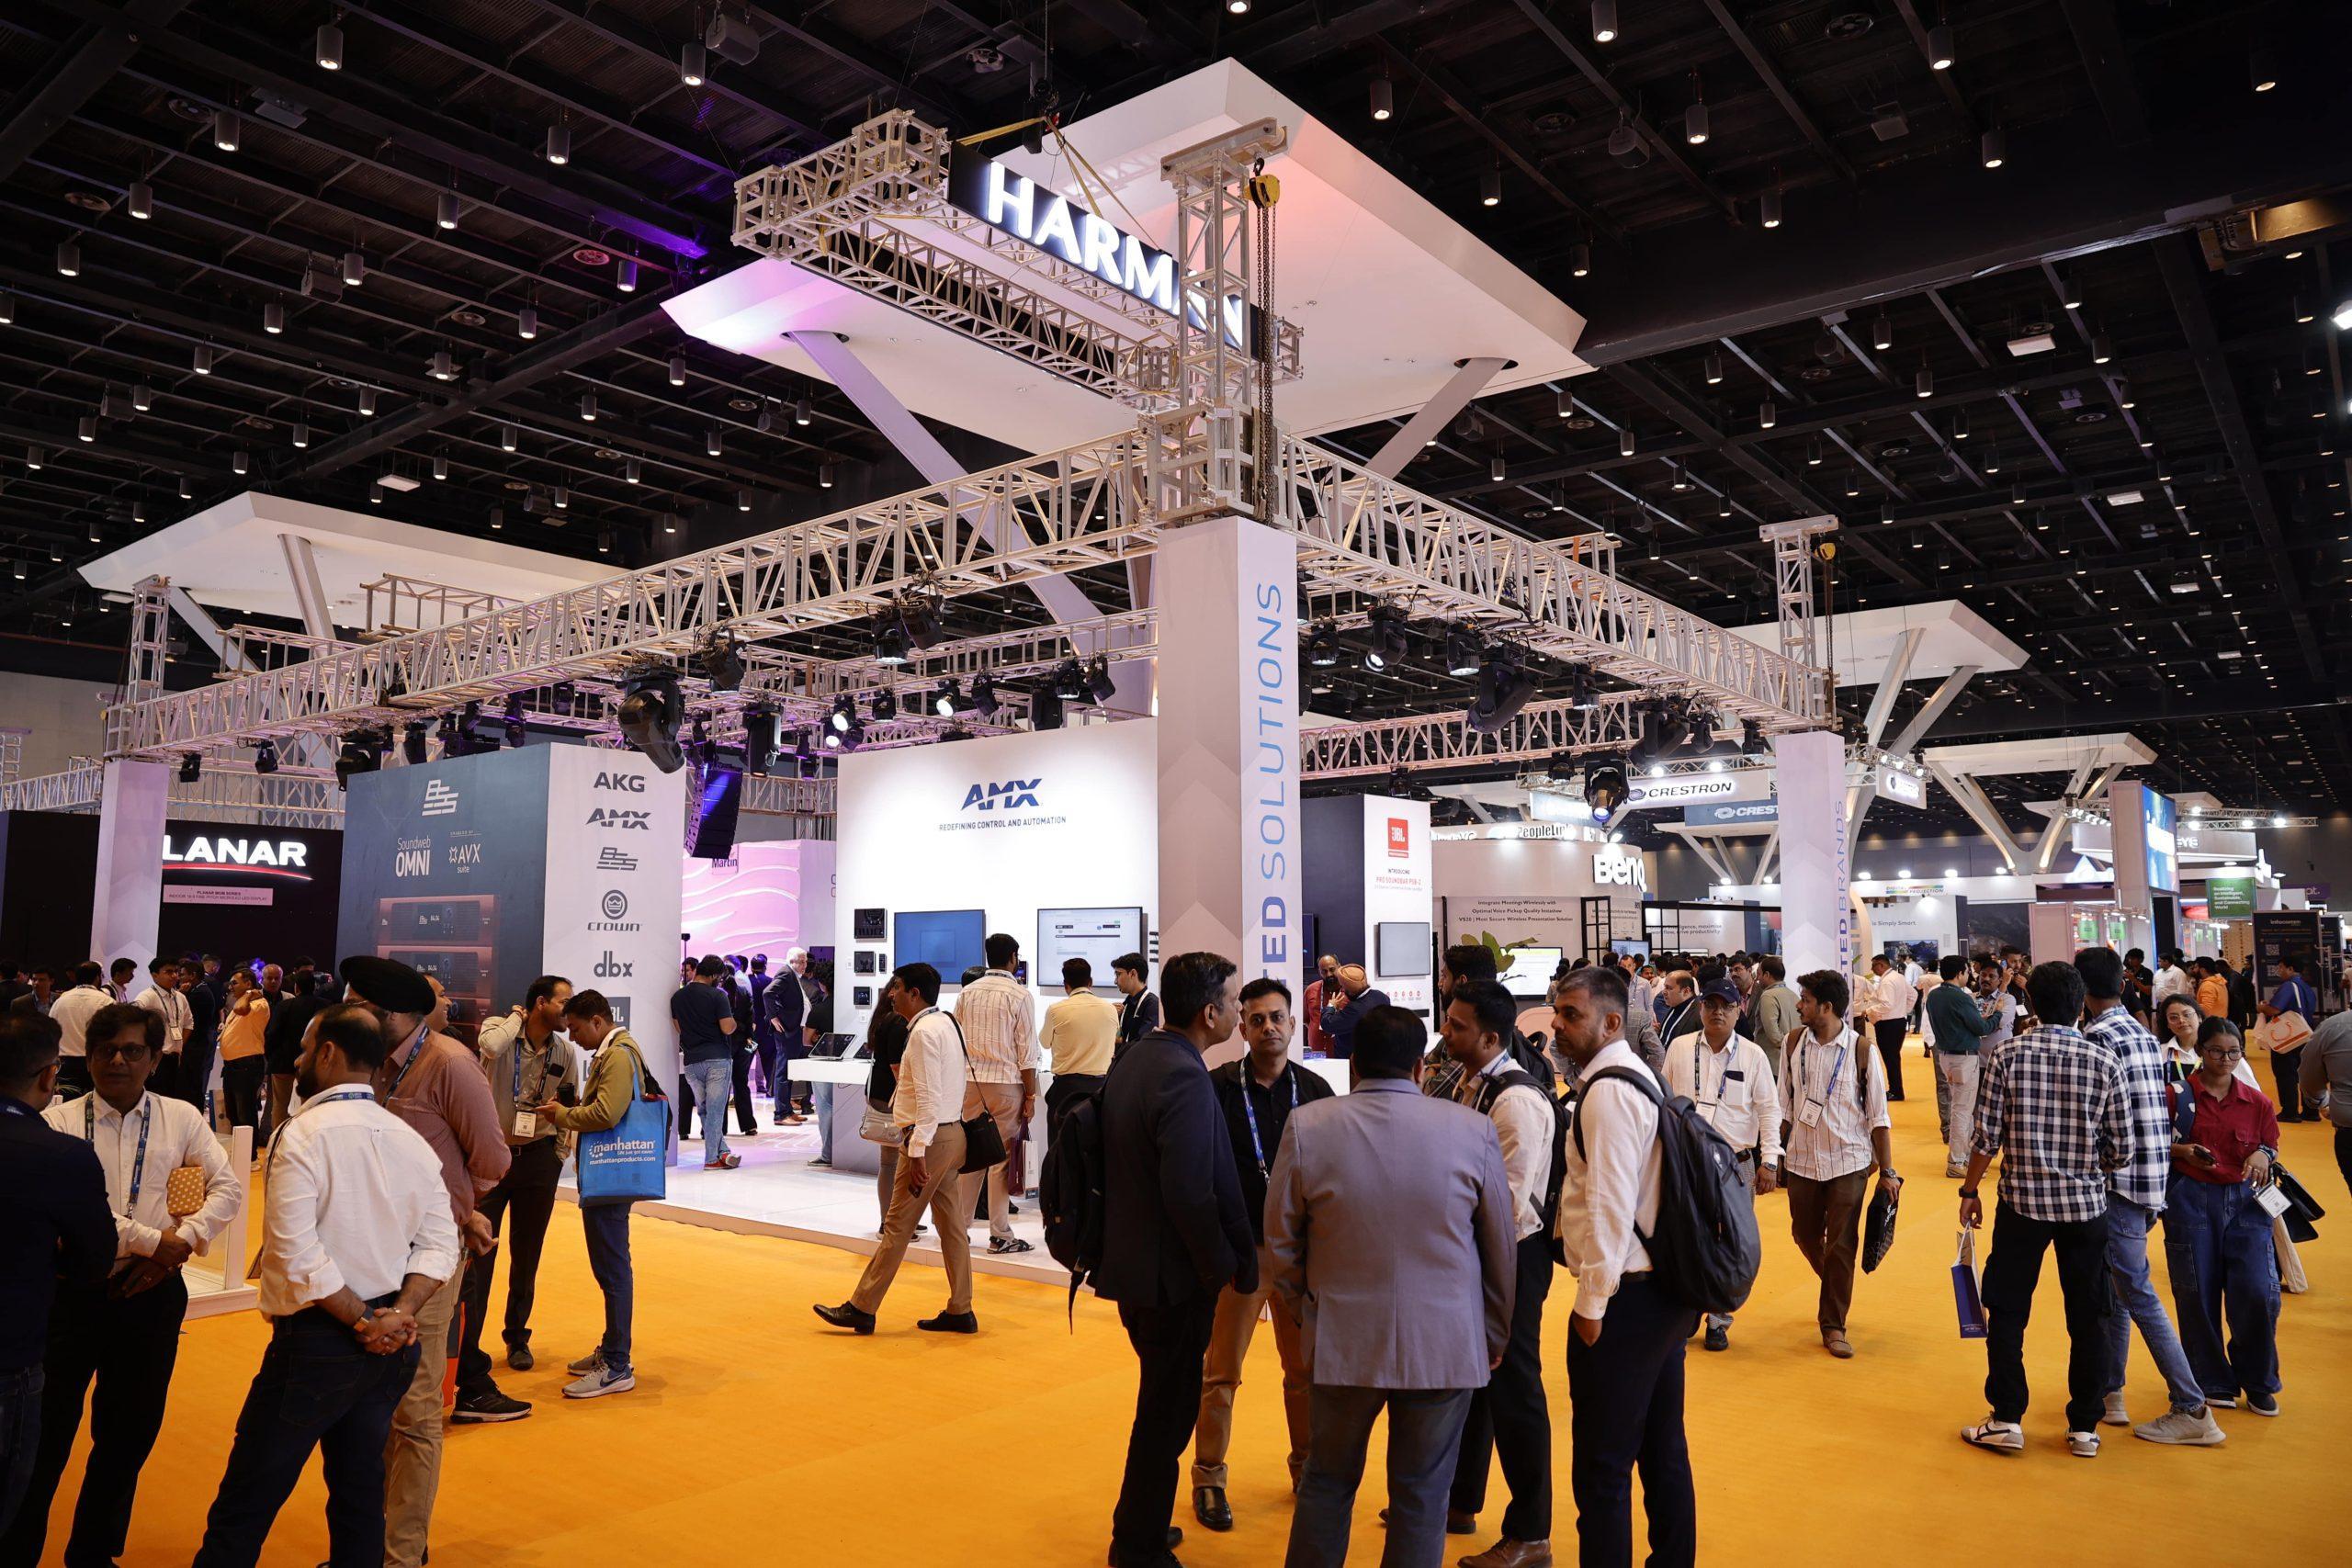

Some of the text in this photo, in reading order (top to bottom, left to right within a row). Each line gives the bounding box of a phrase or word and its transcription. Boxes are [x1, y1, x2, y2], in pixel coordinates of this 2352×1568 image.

[1257, 582, 1286, 881] SOLUTIONS
[594, 772, 645, 793] AKG
[1648, 782, 1732, 798] CRESTRON
[961, 778, 1043, 811] AMX
[585, 807, 652, 830] AMX
[939, 816, 1067, 831] REDEFINING CONTROL AND AUTOMATION
[397, 835, 432, 851] Soundweb
[1391, 827, 1406, 842] JBL
[395, 849, 431, 877] OMNI
[458, 843, 481, 864] AVX
[711, 857, 738, 869] Martin
[1836, 800, 1848, 912] BRANDS
[457, 865, 470, 874] suite
[1592, 853, 1647, 893] BenQ
[587, 921, 640, 931] crown
[593, 950, 633, 977] dbx
[594, 1136, 654, 1154] manhattan
[589, 1156, 656, 1166] manhattanproducts.com
